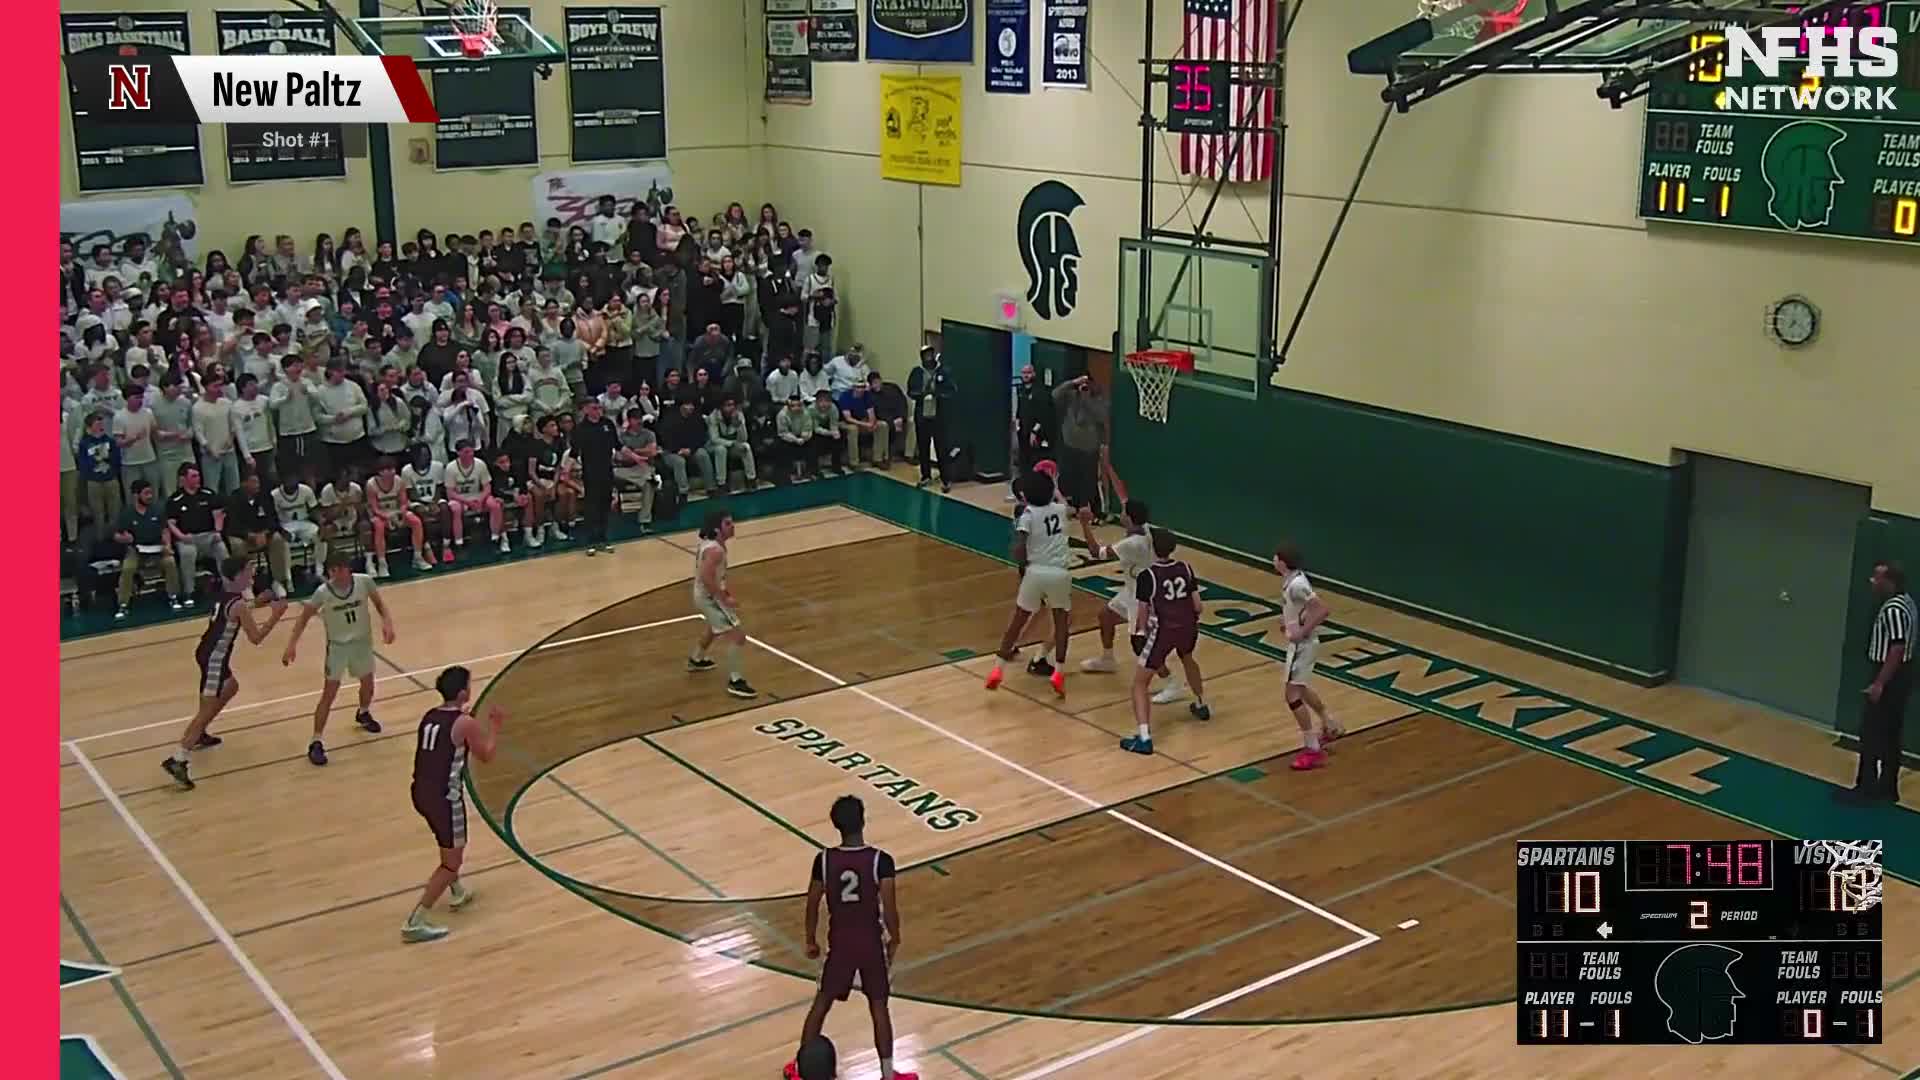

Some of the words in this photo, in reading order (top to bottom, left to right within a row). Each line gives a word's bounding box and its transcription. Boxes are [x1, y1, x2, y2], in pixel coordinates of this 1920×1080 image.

[68, 32, 104, 53] GIRLS
[106, 31, 185, 52] BASKETBALL
[222, 28, 332, 51] BASEBALL
[568, 23, 608, 43] BOYS
[612, 23, 657, 41] CREW
[1055, 68, 1078, 81] 2013
[1173, 64, 1213, 112] 35
[1701, 124, 1734, 139] TEAM
[1883, 134, 1920, 150] TEAM
[1695, 140, 1735, 156] FOULS
[1877, 151, 1920, 168] FOULS
[1648, 162, 1692, 180] PLAYER
[1703, 166, 1742, 182] FOULS
[1659, 181, 1686, 214] 11
[1894, 200, 1917, 235] 0
[1043, 513, 1063, 537] 12
[1162, 577, 1188, 600] 32
[344, 610, 357, 624] 11
[422, 723, 441, 751] 11
[754, 717, 983, 833] SPARTANS
[839, 870, 860, 902] 2
